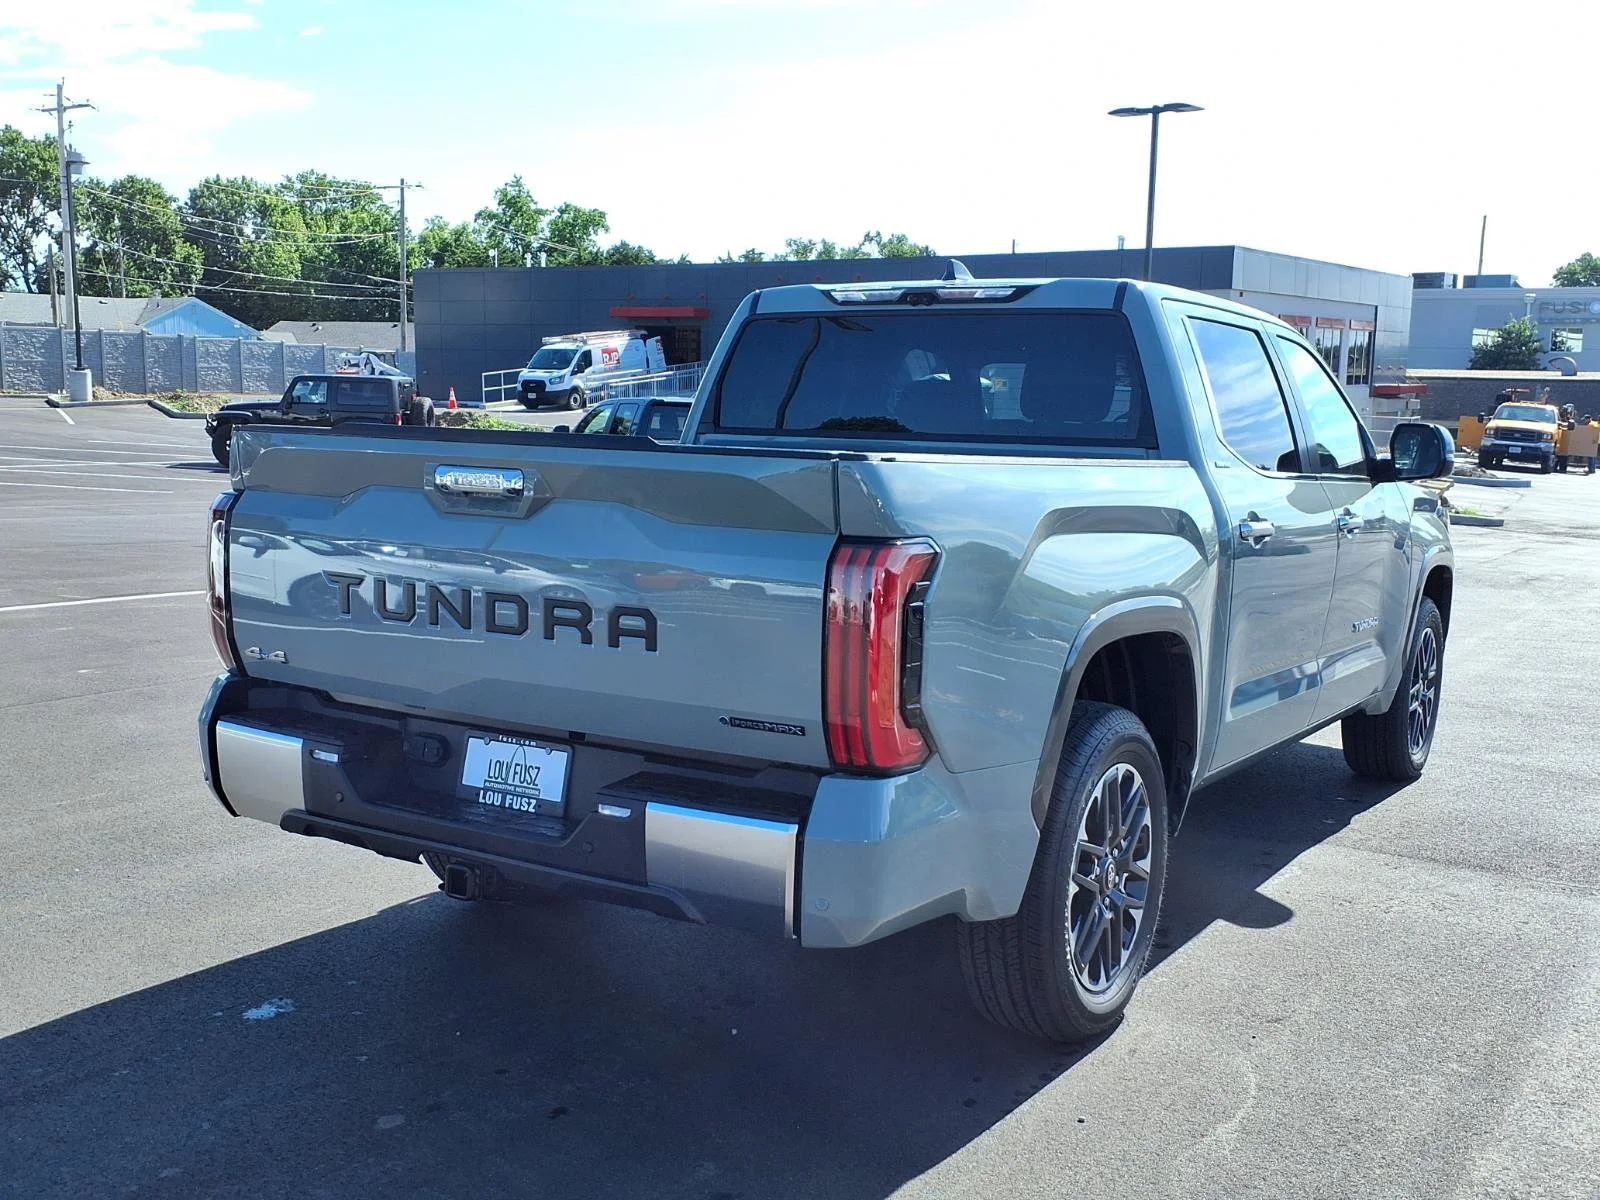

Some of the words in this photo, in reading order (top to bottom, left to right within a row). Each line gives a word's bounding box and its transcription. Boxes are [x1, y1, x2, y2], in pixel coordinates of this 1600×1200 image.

[323, 570, 658, 652] TUNDRA
[487, 759, 508, 782] LOU
[513, 762, 541, 786] FUSZ
[484, 782, 515, 791] AUTOMOTIVE
[479, 790, 502, 806] LOU
[505, 794, 537, 812] FUSZ
